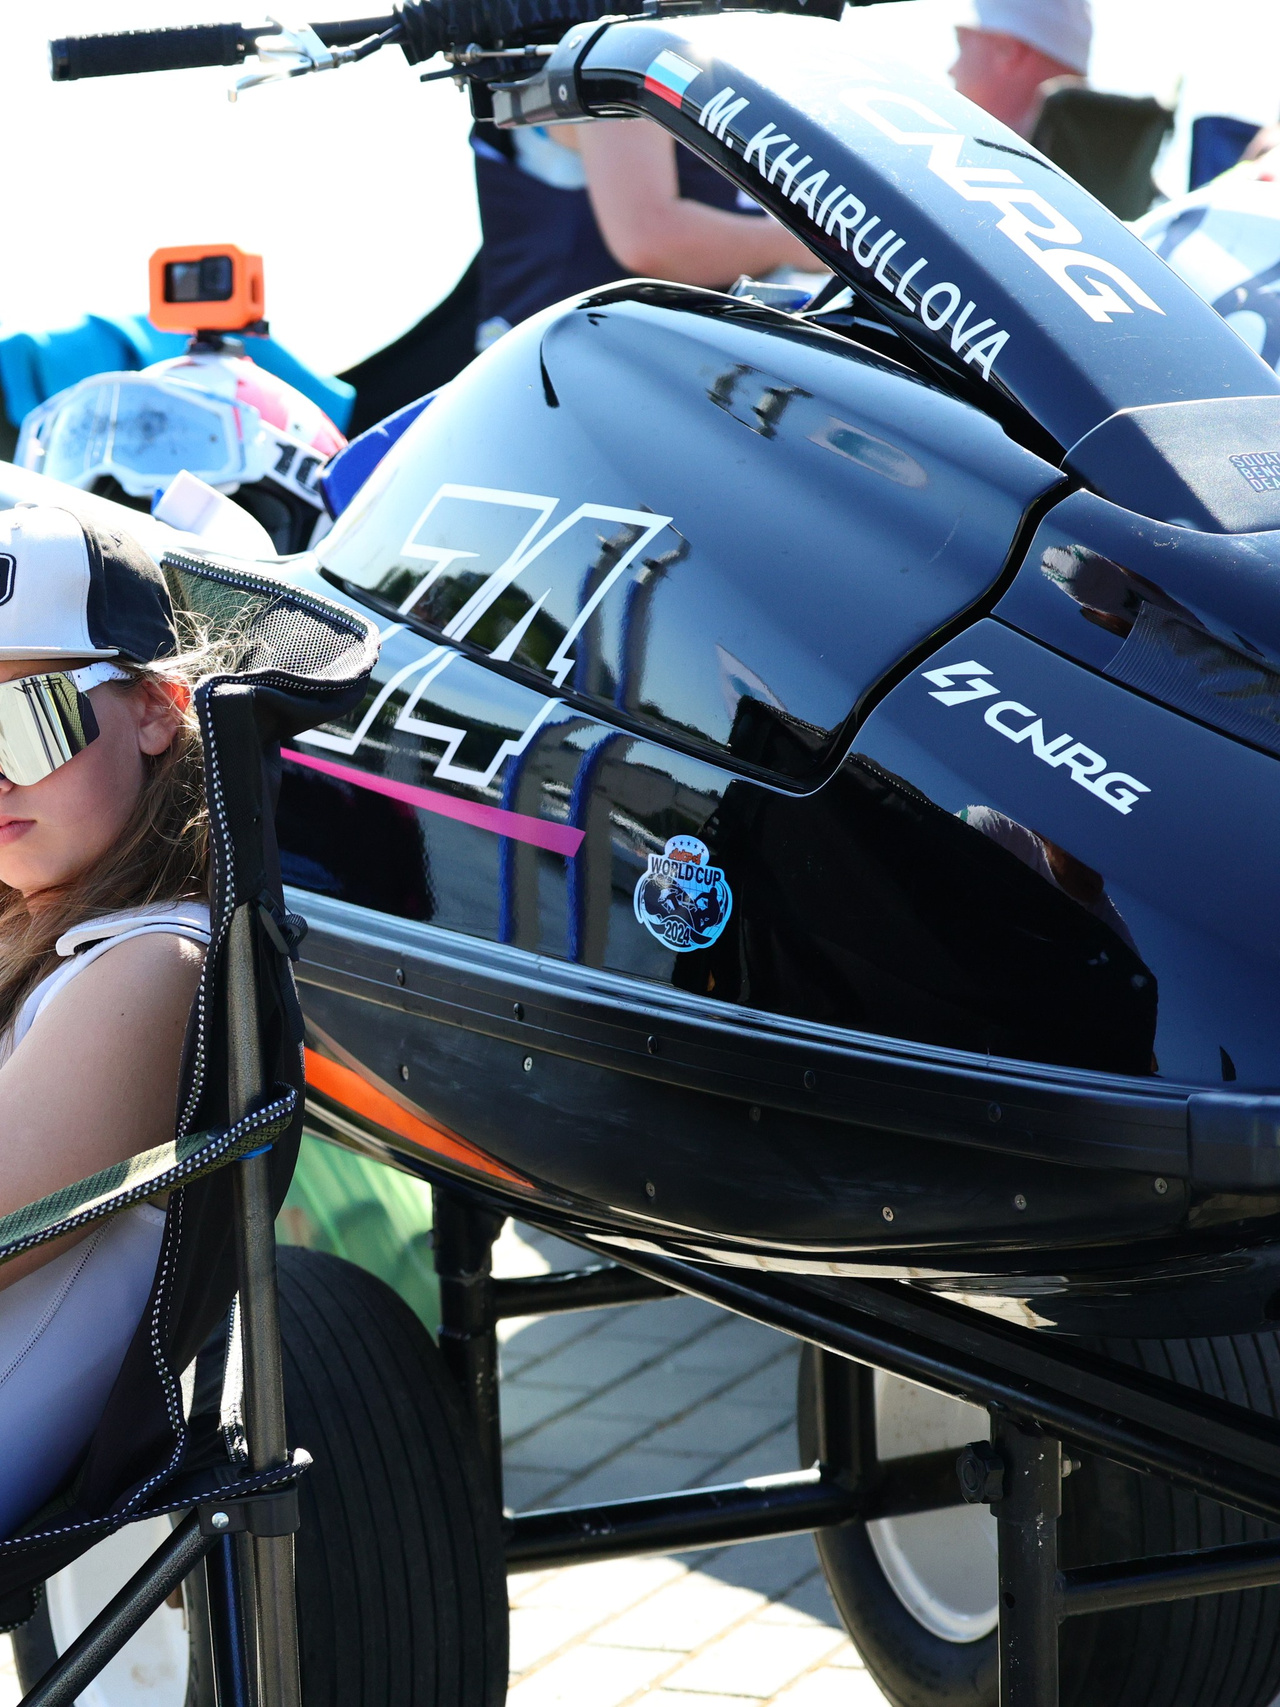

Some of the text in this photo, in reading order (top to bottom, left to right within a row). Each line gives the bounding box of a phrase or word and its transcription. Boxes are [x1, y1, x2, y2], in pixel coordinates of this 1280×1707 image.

[698, 86, 1010, 381] M. KHAIRULLOVA
[837, 86, 1167, 323] CNRG
[984, 700, 1152, 815] CNRG
[652, 857, 721, 886] WORLD CUP
[665, 922, 689, 943] 2024
